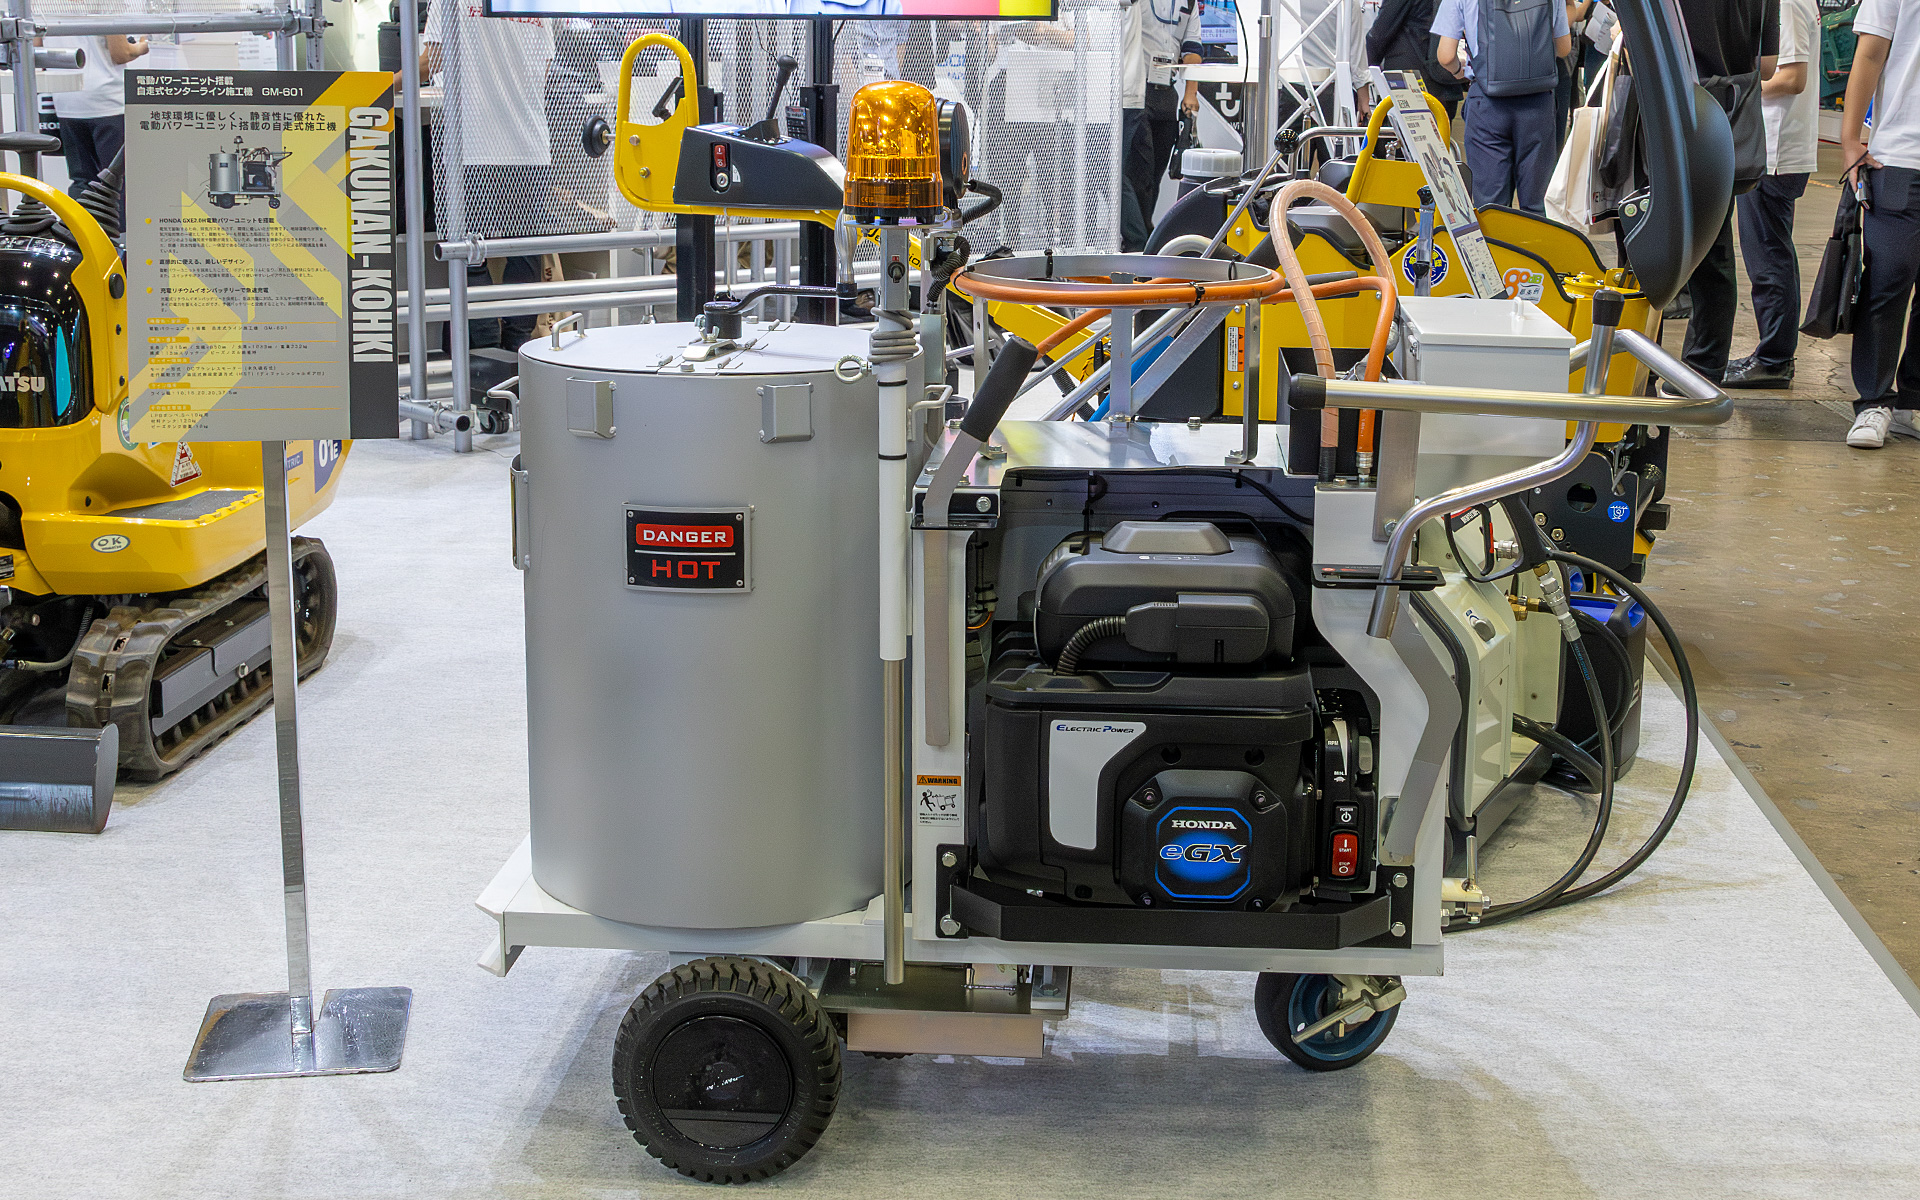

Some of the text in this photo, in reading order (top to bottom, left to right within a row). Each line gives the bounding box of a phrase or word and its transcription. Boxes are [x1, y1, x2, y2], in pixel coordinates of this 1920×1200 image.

[136, 76, 234, 86] 電動パワーユニット搭載
[136, 87, 304, 97] 自走式センターライン施工機 GM-601
[150, 111, 326, 121] 地球環境に優しく、静音性に優れた
[139, 121, 338, 132] 電動パワーユニット搭載の自走式施工機
[349, 106, 394, 362] GAKUNAN-KOHKI
[643, 529, 728, 544] DANGER
[651, 559, 721, 580] HOT
[927, 777, 958, 785] WARNING
[1171, 819, 1237, 830] HONDA
[1159, 843, 1248, 864] eGX
